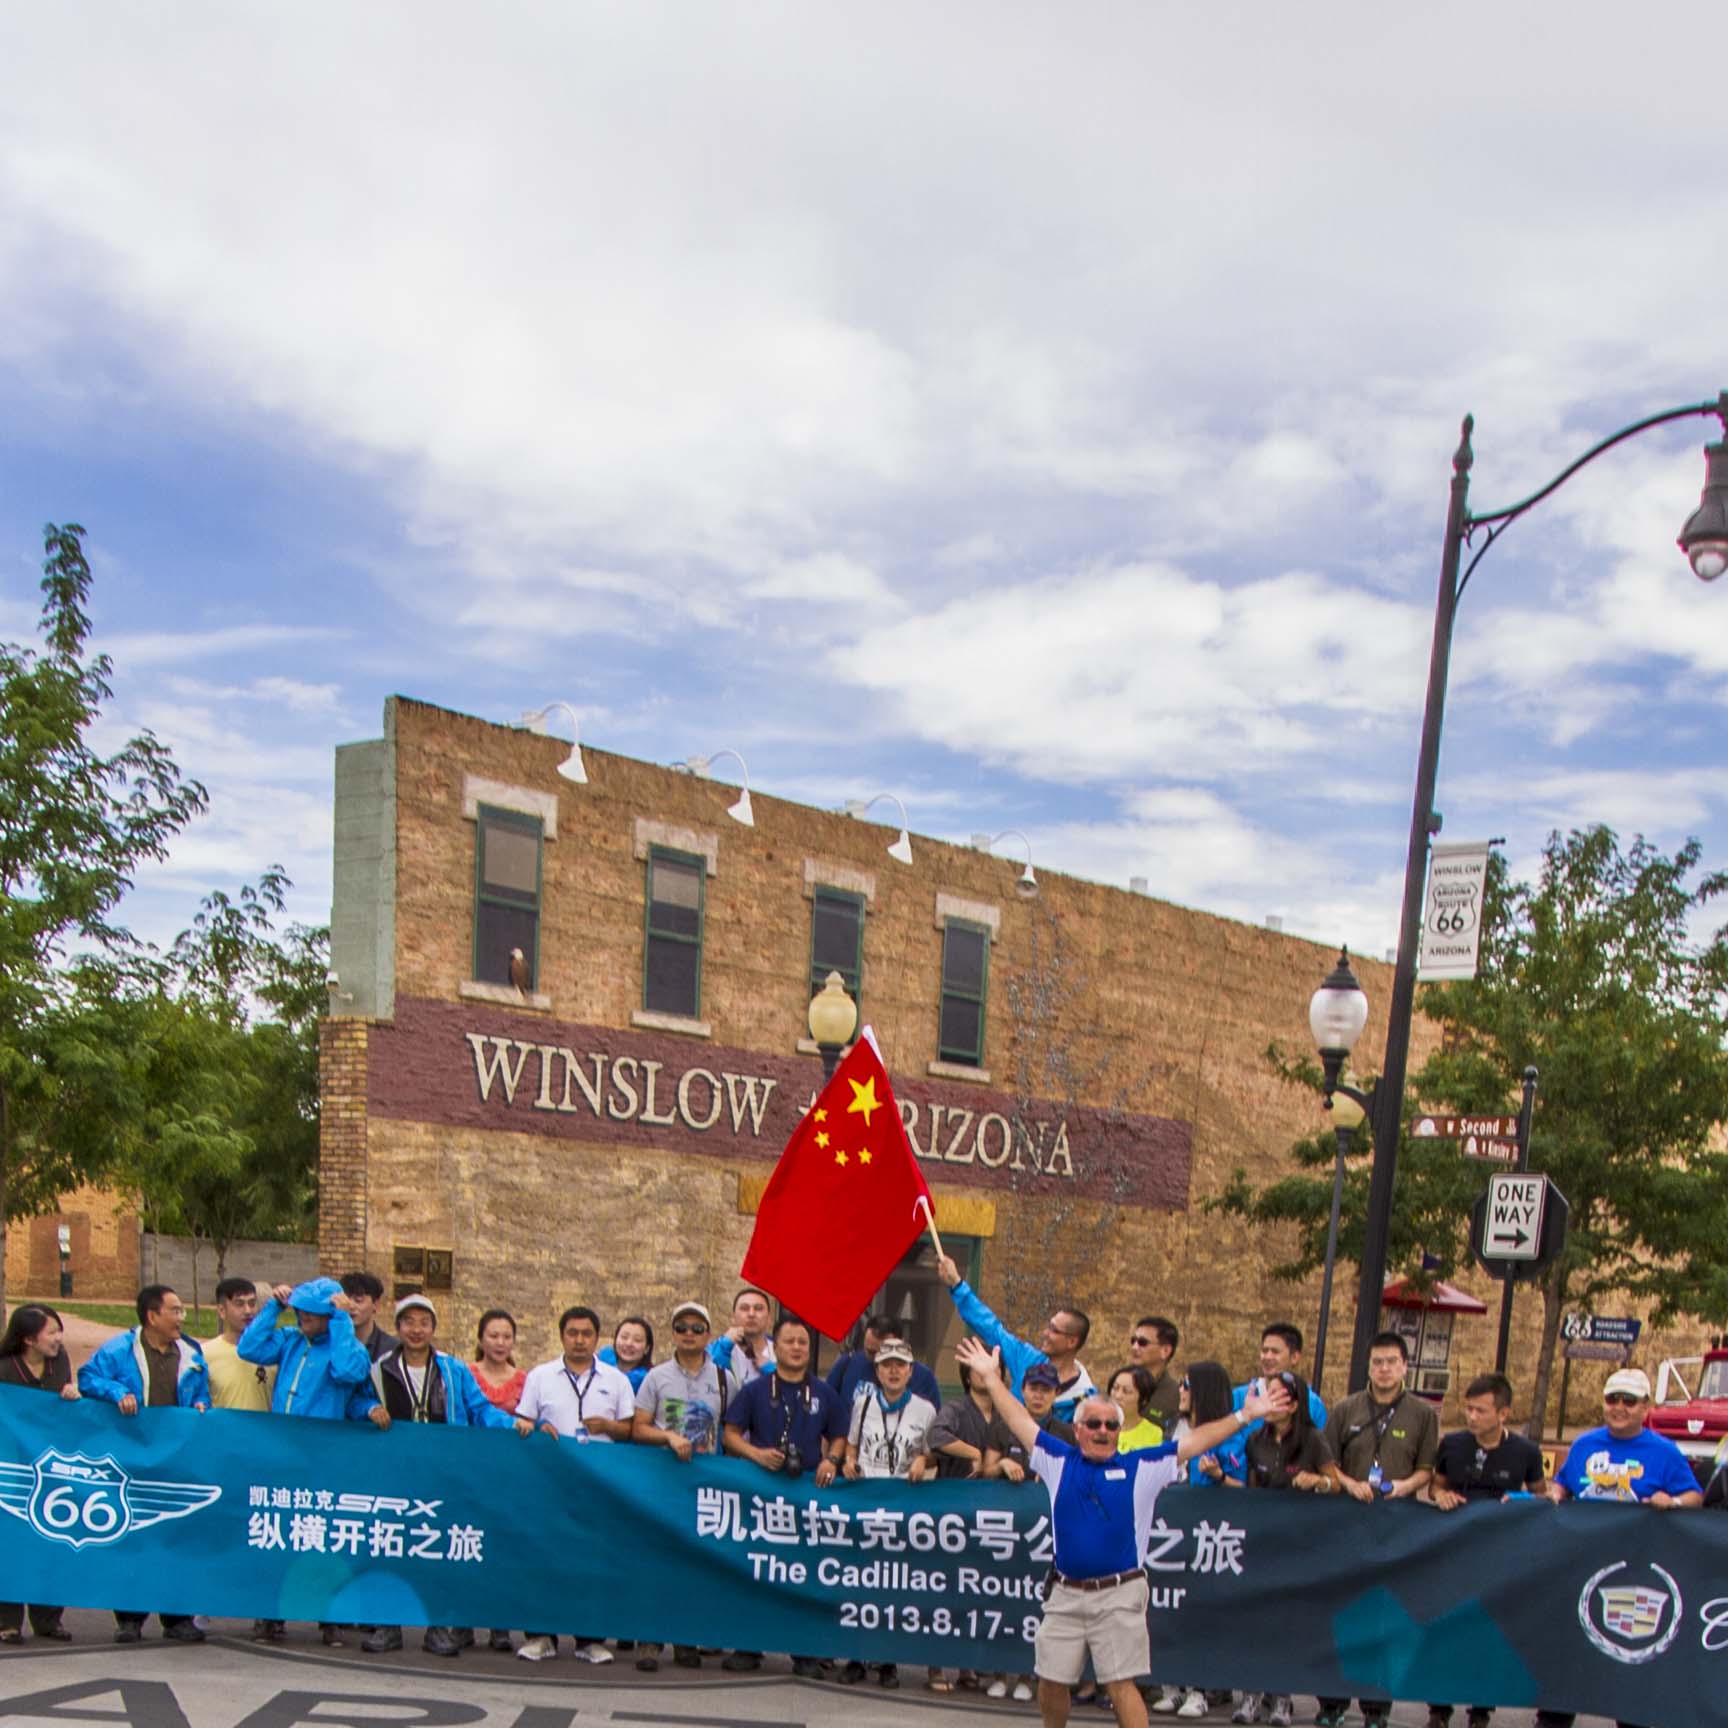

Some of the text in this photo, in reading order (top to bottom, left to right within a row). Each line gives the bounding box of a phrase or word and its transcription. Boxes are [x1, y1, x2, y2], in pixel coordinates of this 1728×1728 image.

[1437, 903, 1464, 932] 66
[1429, 945, 1472, 957] ARIZONA
[465, 1032, 1073, 1176] WINSLOW RIZONA
[1460, 1118, 1499, 1136] Second
[1497, 1183, 1536, 1202] ONE
[1495, 1205, 1535, 1225] WAY
[50, 1461, 112, 1480] SRX
[42, 1486, 117, 1532] 66
[248, 1511, 485, 1562] 纵横开拓之旅
[747, 1552, 807, 1584] The
[817, 1557, 947, 1592] Cadillac
